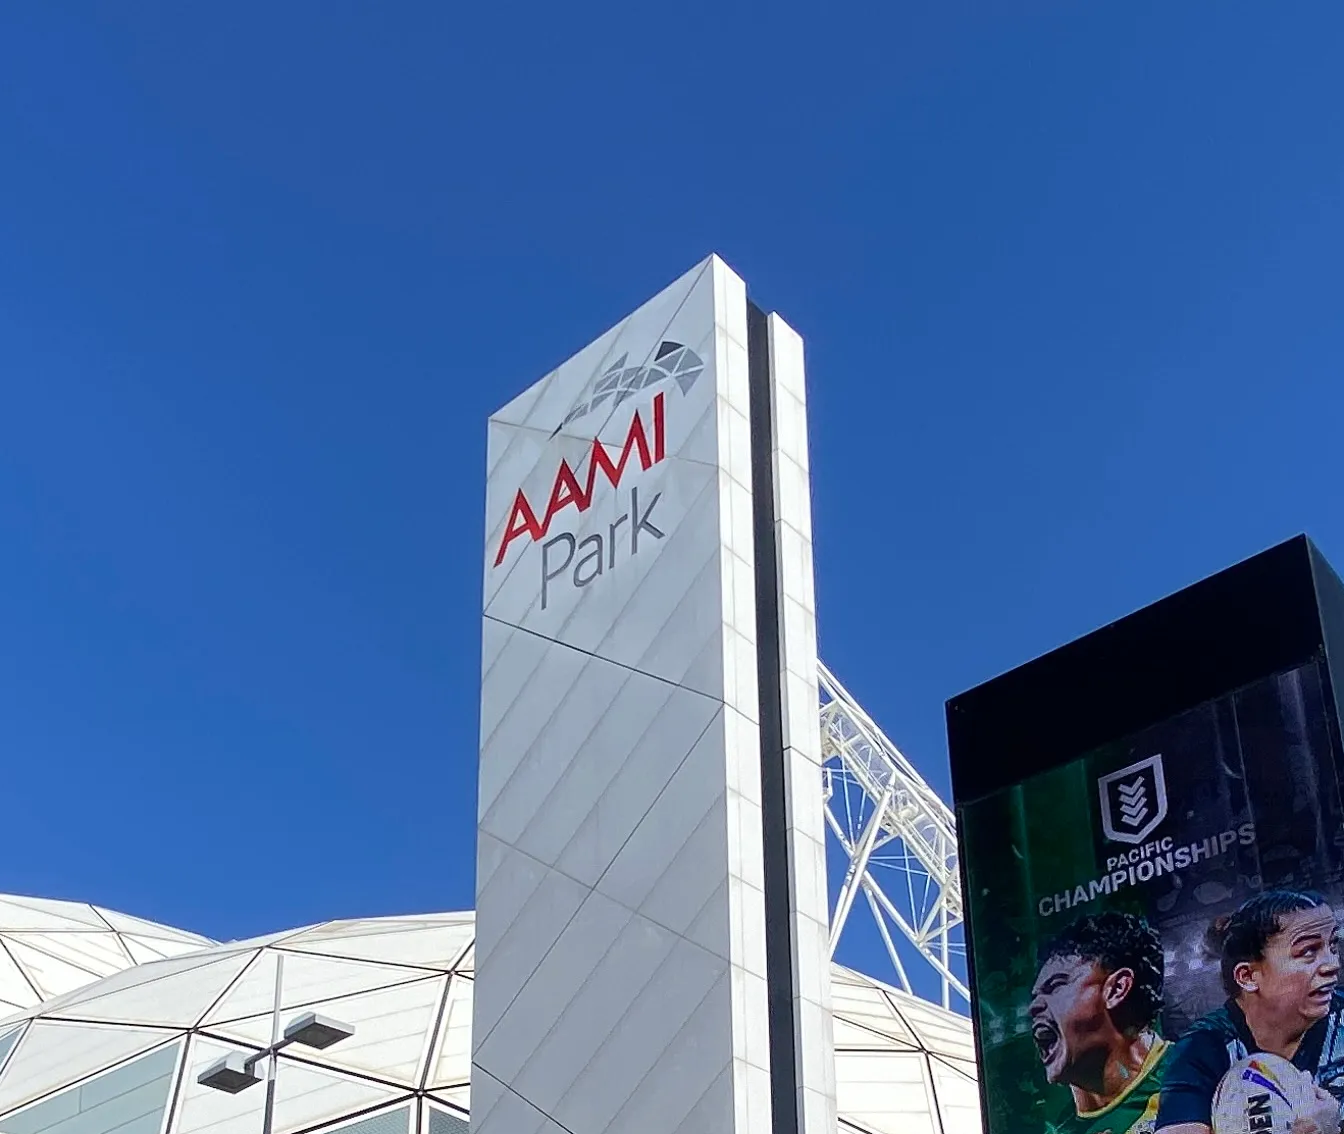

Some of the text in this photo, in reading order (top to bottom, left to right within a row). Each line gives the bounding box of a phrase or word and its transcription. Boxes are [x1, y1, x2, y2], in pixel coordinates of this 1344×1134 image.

[493, 391, 665, 568] AAMI
[540, 487, 665, 611] Park
[1038, 823, 1256, 917] CHAMPIONSHIPS
[1106, 836, 1174, 872] PACIFIC
